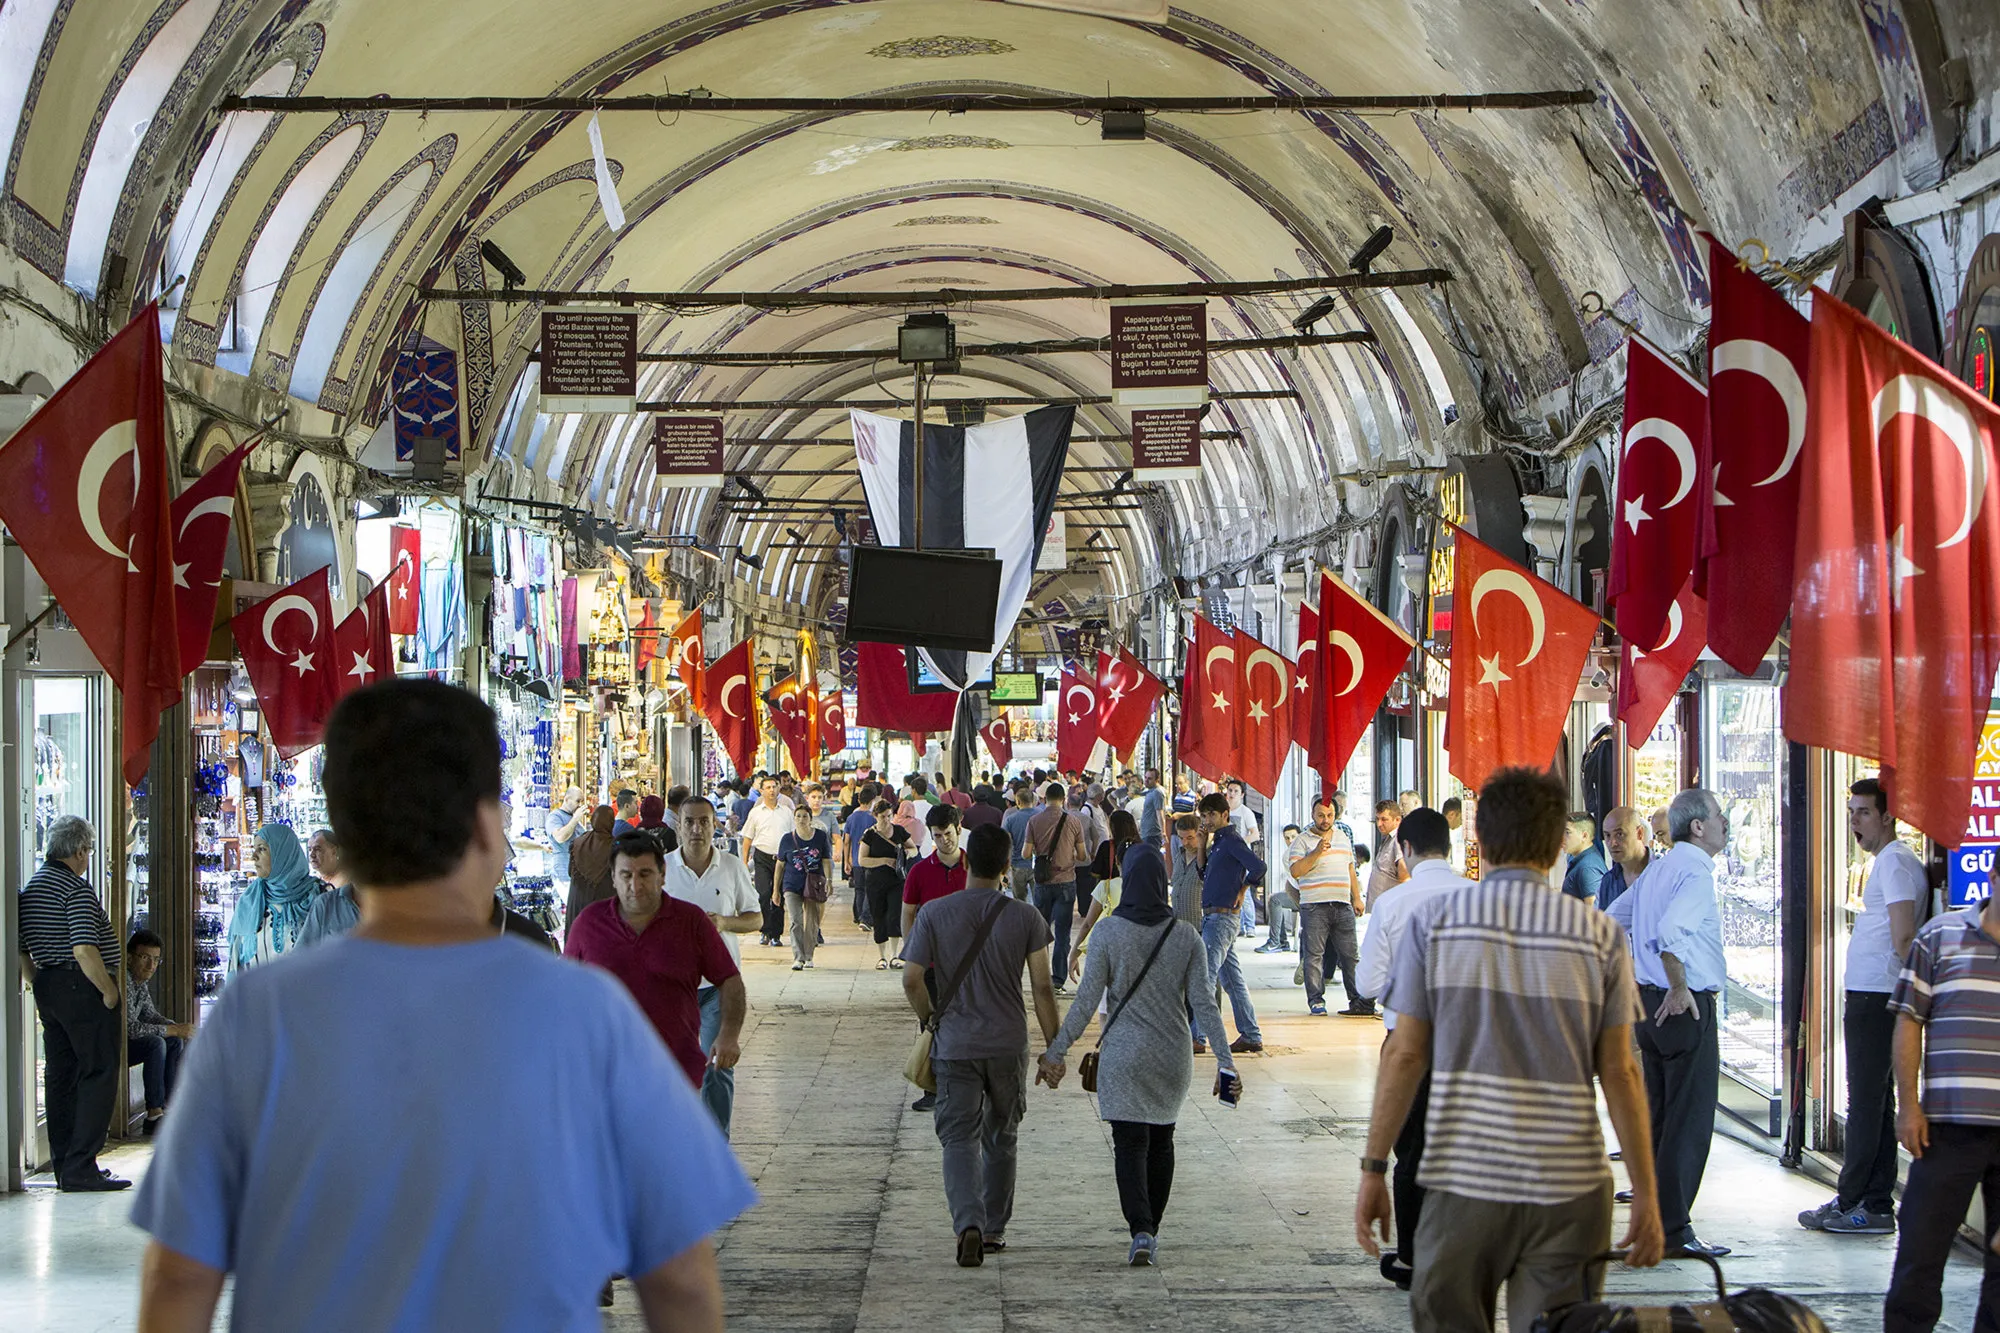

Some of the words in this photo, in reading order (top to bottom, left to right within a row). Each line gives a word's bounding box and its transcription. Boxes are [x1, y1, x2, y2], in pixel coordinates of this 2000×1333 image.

[556, 315, 566, 323] Up
[1174, 315, 1192, 323] yakın
[560, 341, 593, 349] fountains,
[552, 367, 573, 375] Today
[1970, 786, 2000, 807] AL
